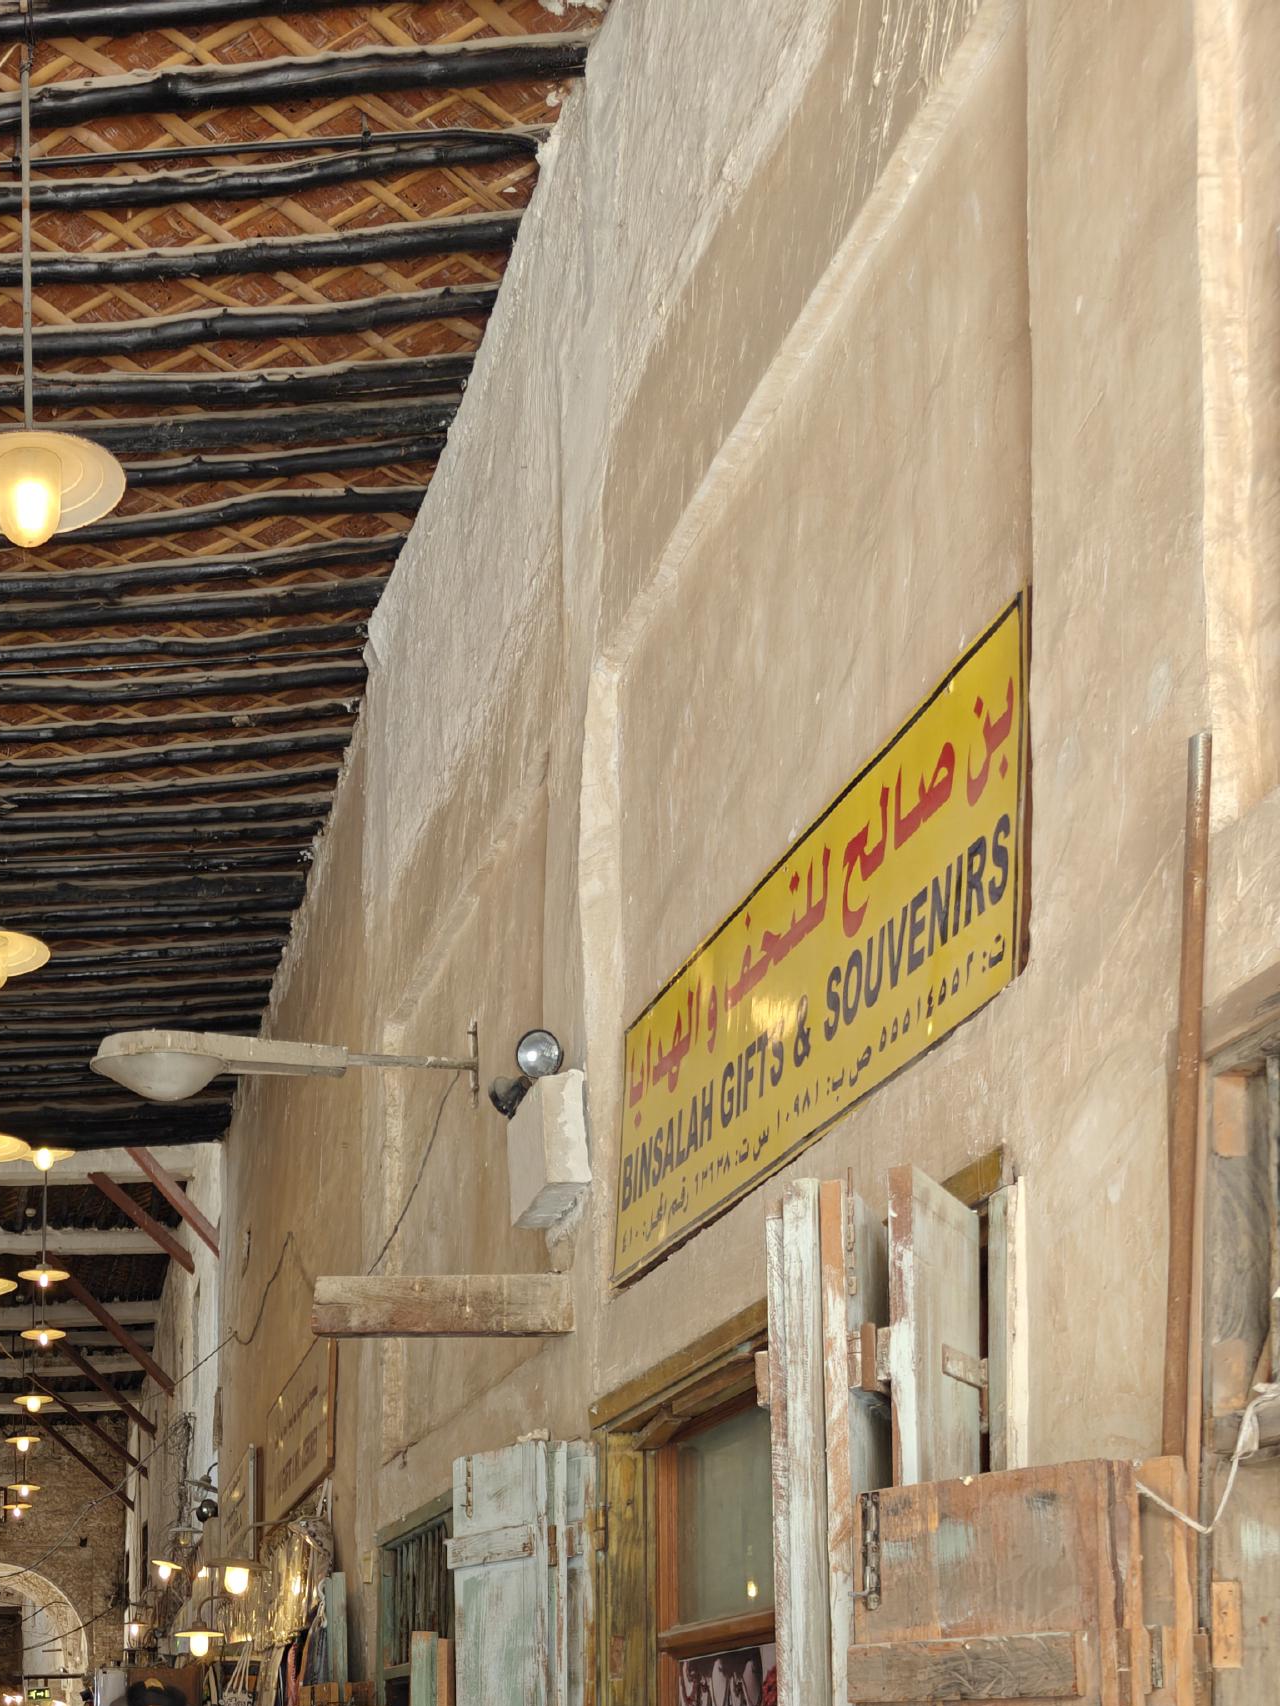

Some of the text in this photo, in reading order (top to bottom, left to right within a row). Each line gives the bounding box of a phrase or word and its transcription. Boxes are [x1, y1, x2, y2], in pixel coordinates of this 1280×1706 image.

[966, 676, 1014, 807] بن
[724, 843, 831, 1013] للتحف
[842, 742, 956, 938] صالح
[622, 813, 1011, 1212] BINSALAH GIFTS & SOUVENIRS
